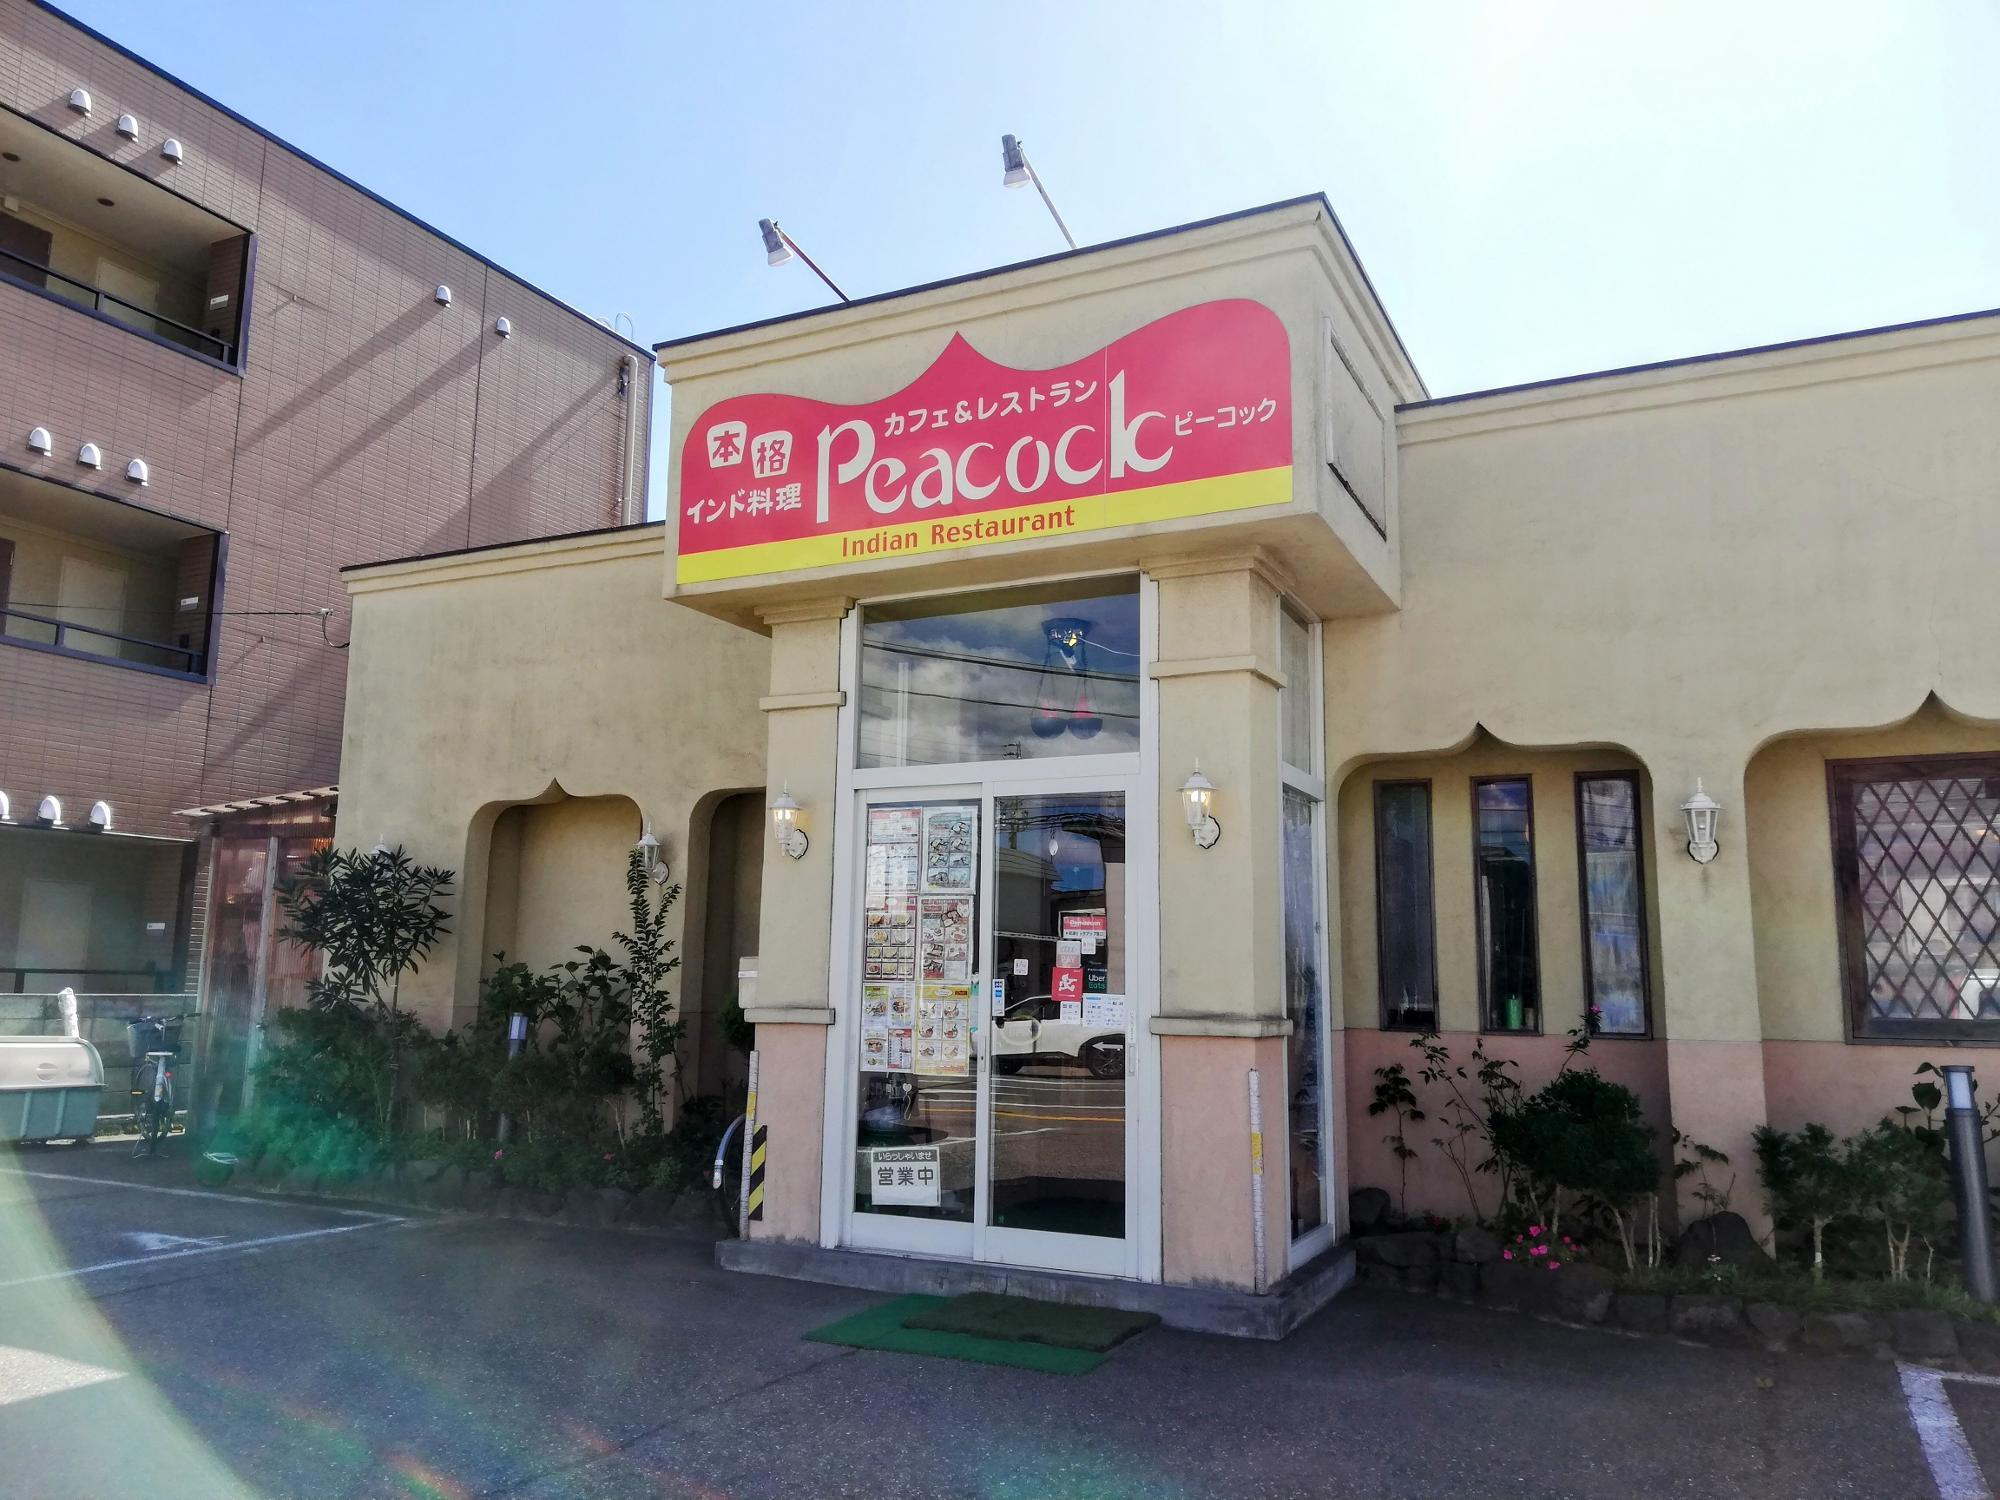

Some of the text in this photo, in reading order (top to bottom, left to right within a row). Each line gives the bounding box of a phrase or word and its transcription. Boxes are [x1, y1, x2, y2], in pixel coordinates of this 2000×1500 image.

[885, 380, 1097, 437] カフェ&レストラン
[1174, 397, 1277, 436] ピーコック
[706, 420, 793, 479] 本格
[815, 370, 1174, 524] Peacock
[687, 482, 803, 525] インド料理
[842, 506, 1075, 558] Indian Restaurant
[1088, 974, 1106, 982] Uber
[877, 1166, 934, 1186] 営業中
